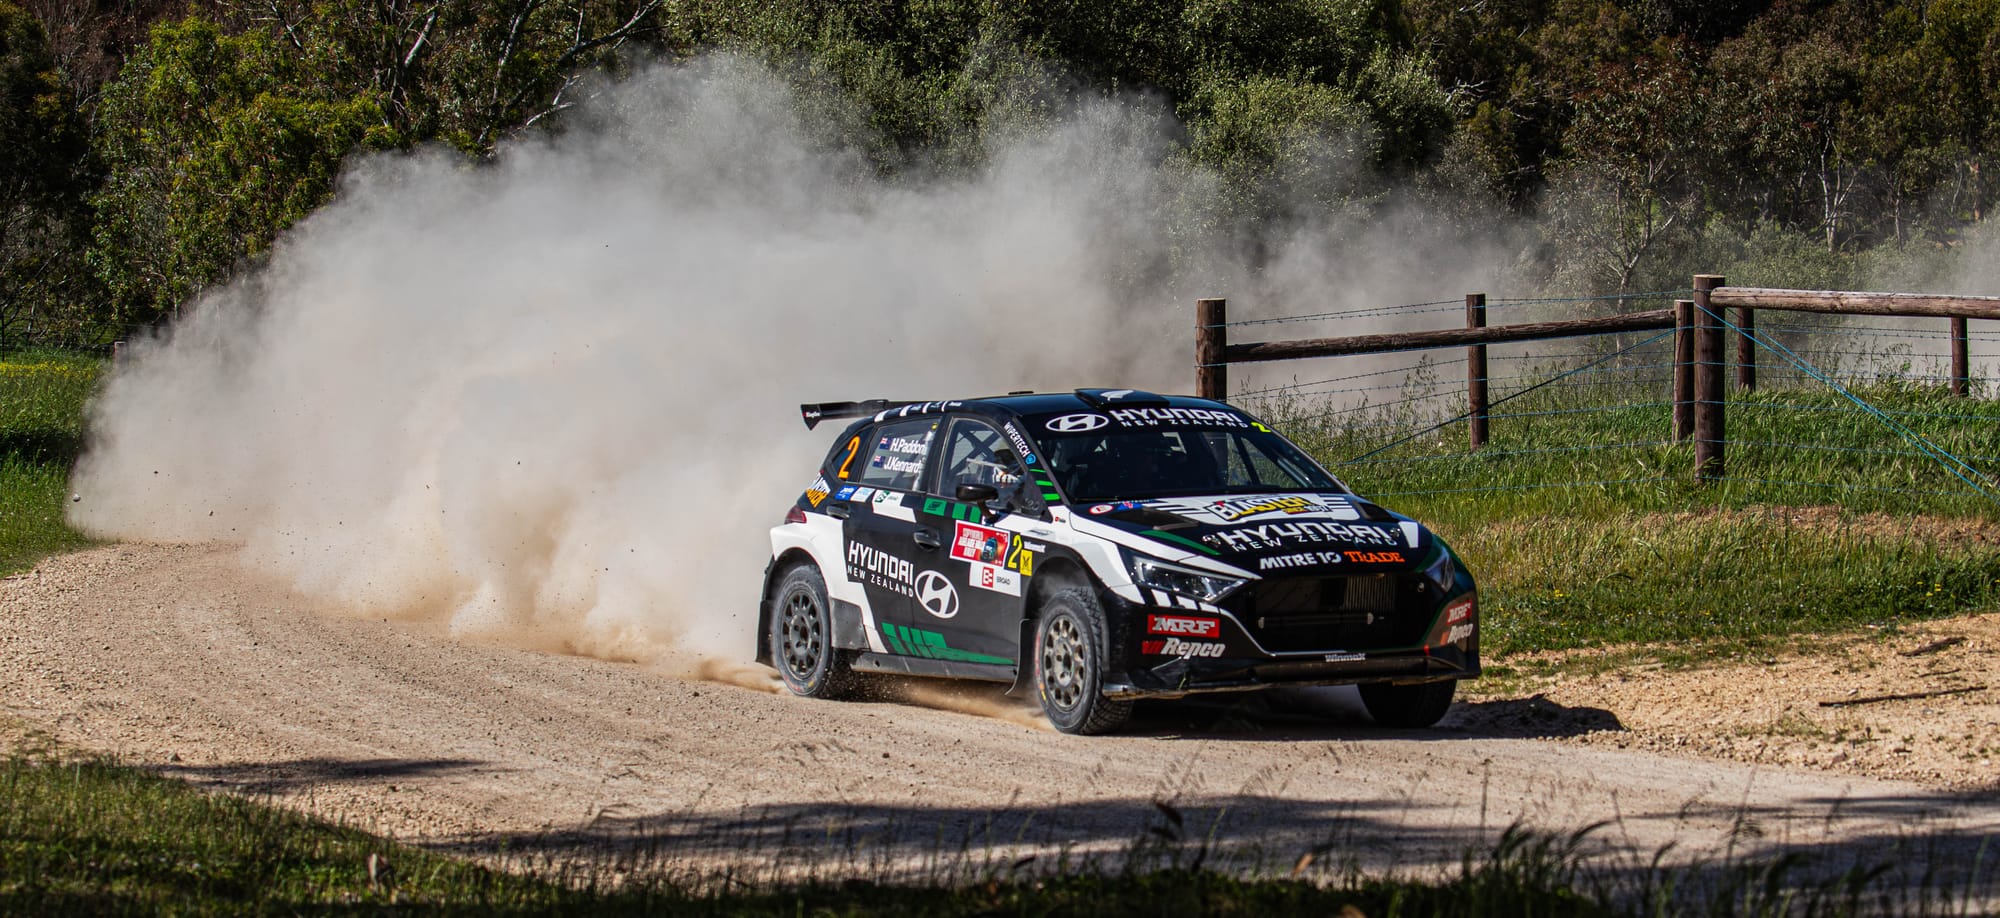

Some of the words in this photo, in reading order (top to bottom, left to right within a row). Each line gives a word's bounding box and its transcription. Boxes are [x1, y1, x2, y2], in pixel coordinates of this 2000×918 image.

[1109, 408, 1244, 423] HYUNDAI
[1169, 419, 1249, 428] ZEALAND
[1003, 421, 1031, 458] WIPERTECH
[837, 436, 860, 479] 2
[1217, 522, 1392, 546] HYUNDAI
[1232, 537, 1282, 552] NEW
[1294, 534, 1398, 546] ZEALAND
[848, 540, 914, 586] HYUNDAI
[1007, 535, 1022, 569] 2
[1259, 552, 1317, 570] MITRE
[1316, 552, 1342, 563] 10
[1344, 551, 1405, 563] TRADE
[847, 565, 866, 580] NEW
[870, 574, 914, 598] ZEALAND
[1152, 617, 1216, 634] MRF
[1160, 637, 1226, 660] Repco
